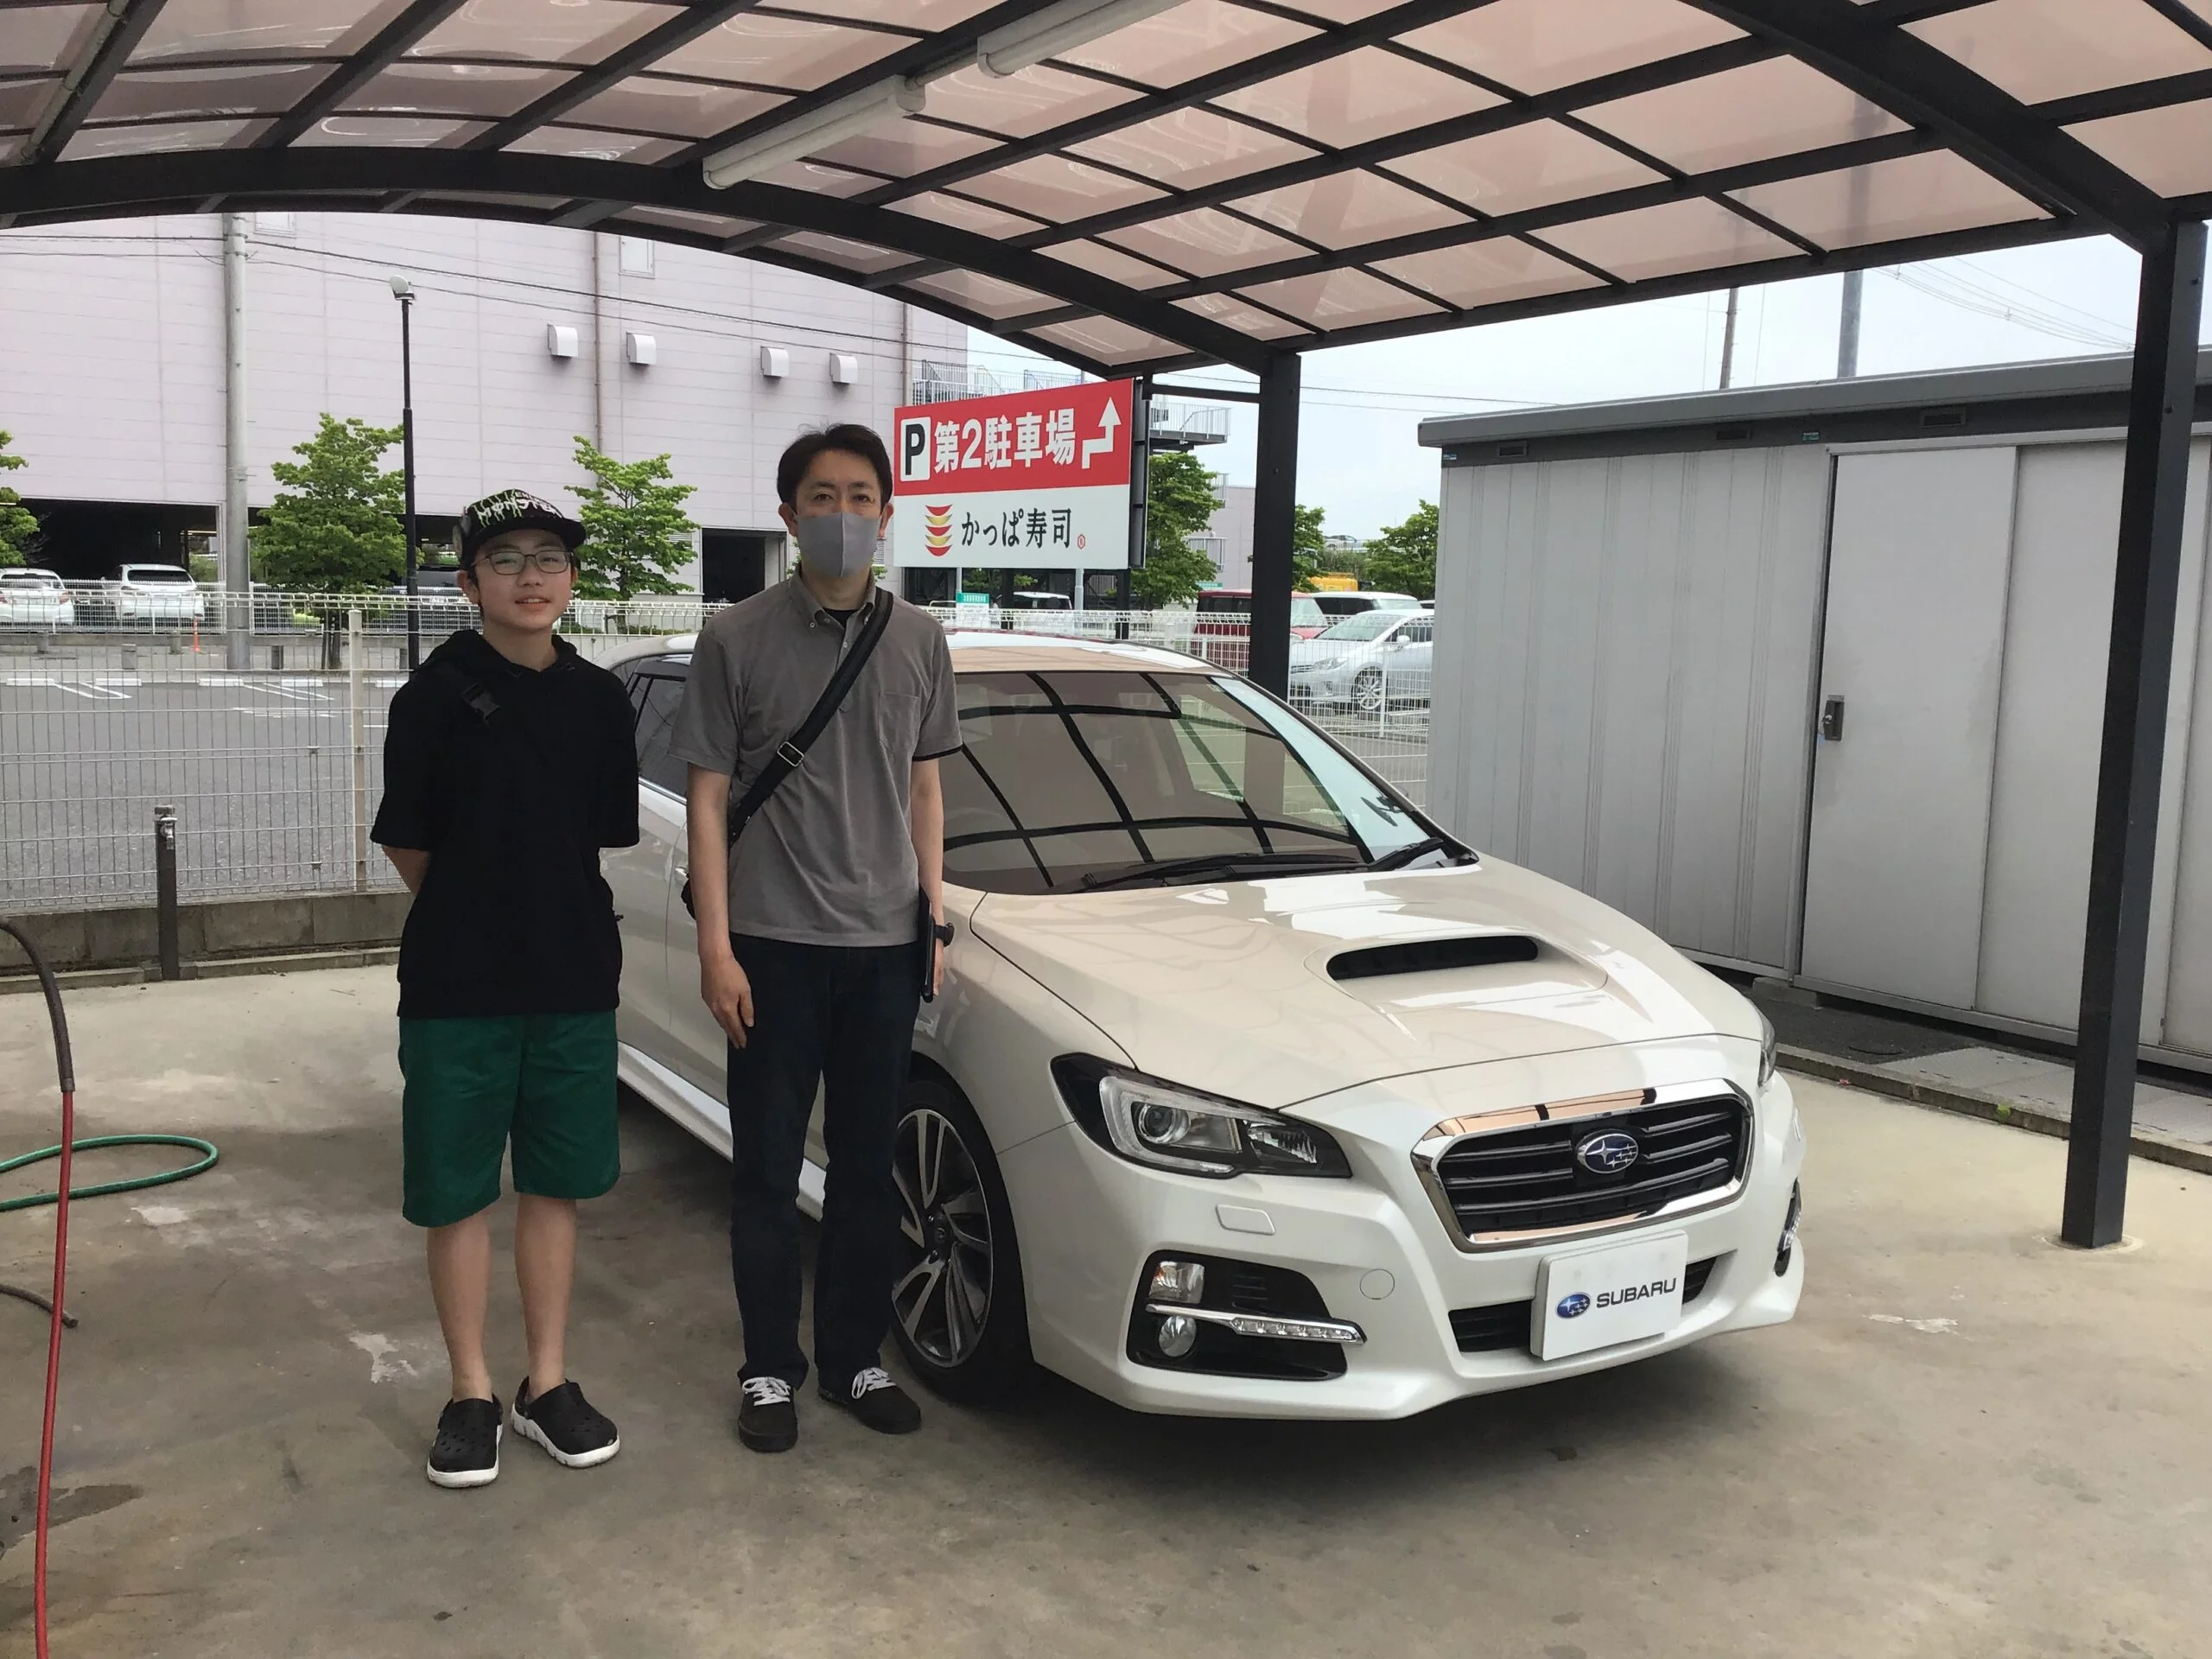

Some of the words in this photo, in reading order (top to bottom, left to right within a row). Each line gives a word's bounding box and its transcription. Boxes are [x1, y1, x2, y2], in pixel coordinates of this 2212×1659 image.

[906, 423, 926, 475] P
[934, 408, 1076, 474] 第2駐車場
[961, 508, 1071, 549] かっぱ寿司
[1595, 1277, 1677, 1308] SUBARU
